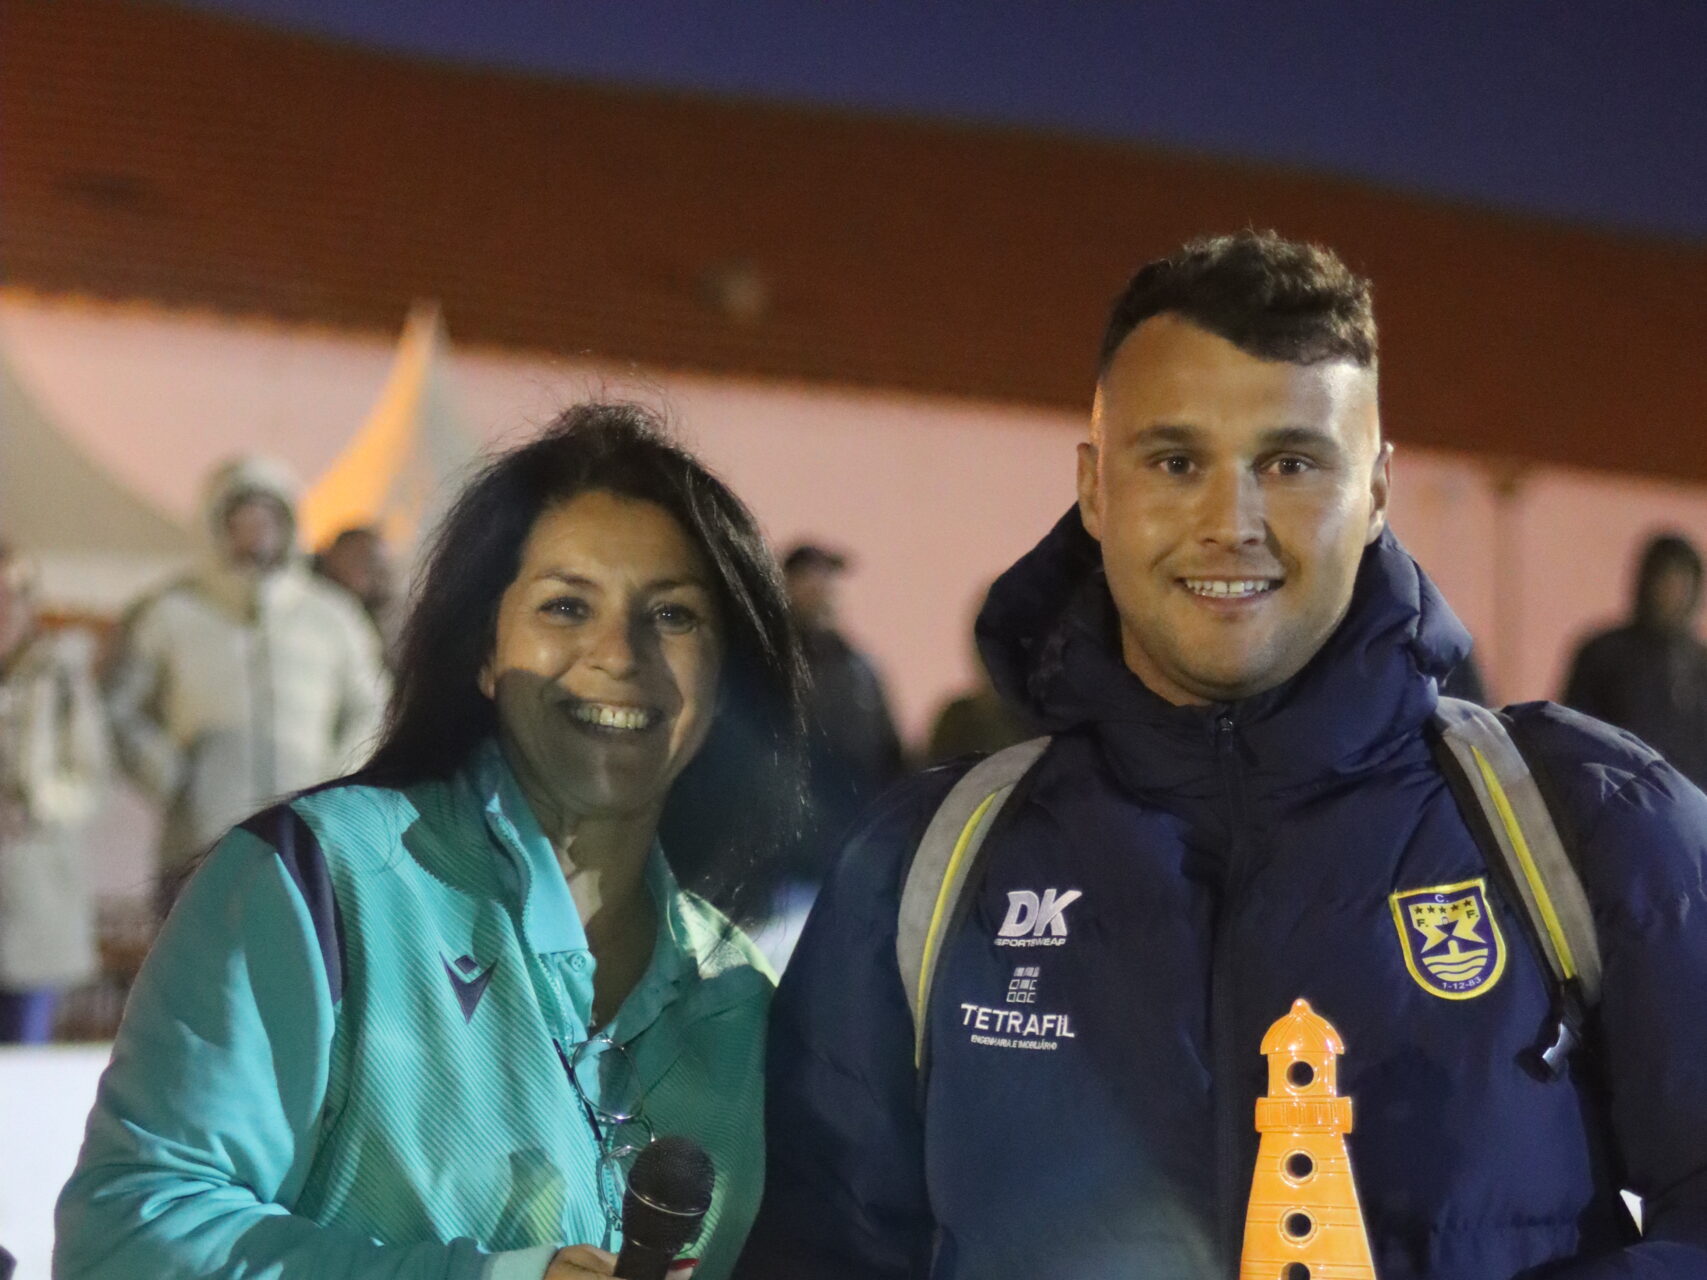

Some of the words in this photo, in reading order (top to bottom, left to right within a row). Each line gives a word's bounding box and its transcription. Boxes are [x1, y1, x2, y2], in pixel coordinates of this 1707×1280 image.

[997, 888, 1083, 937] DK
[1442, 976, 1482, 990] 1-12-83
[960, 1003, 1075, 1038] TETRAFIL
